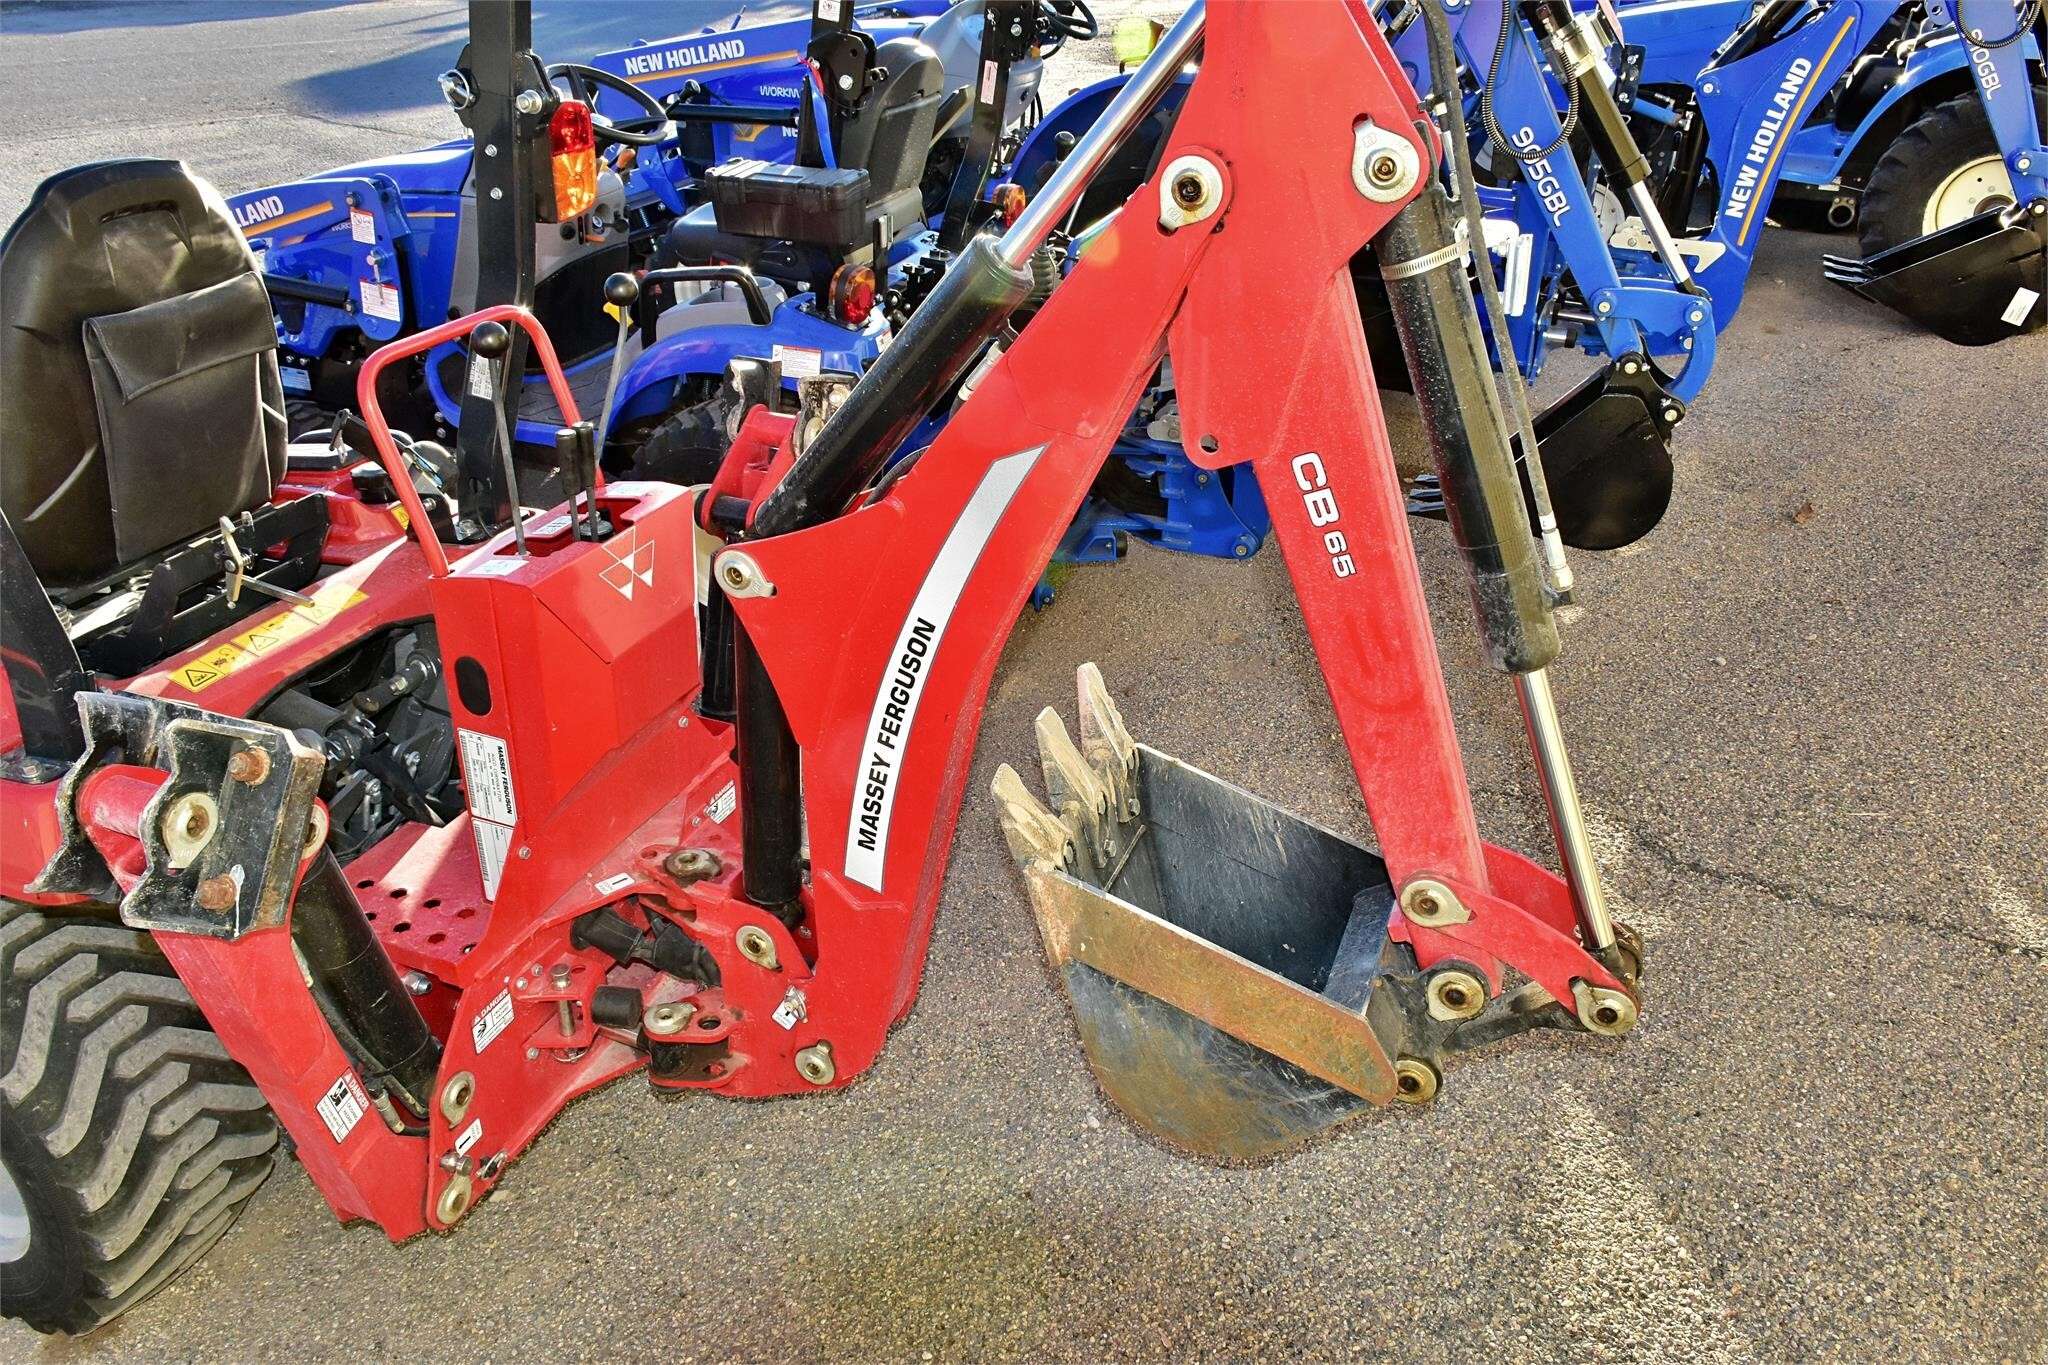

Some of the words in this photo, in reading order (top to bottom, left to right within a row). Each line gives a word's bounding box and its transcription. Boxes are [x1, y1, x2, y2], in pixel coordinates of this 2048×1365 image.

[624, 50, 663, 76] NEW
[665, 39, 745, 69] HOLLAND
[1724, 164, 1760, 219] NEW
[1746, 57, 1812, 164] HOLLAND
[1511, 126, 1571, 227] 905GBL
[238, 195, 285, 228] LAND
[1291, 451, 1341, 528] CB
[1323, 529, 1357, 578] 65
[857, 752, 892, 852] MASSEY
[878, 617, 936, 751] FERGUSON
[497, 745, 507, 776] MASSEY
[501, 775, 513, 815] FERGUSON
[480, 988, 508, 1017] DANGER
[347, 1079, 370, 1109] DANGER
